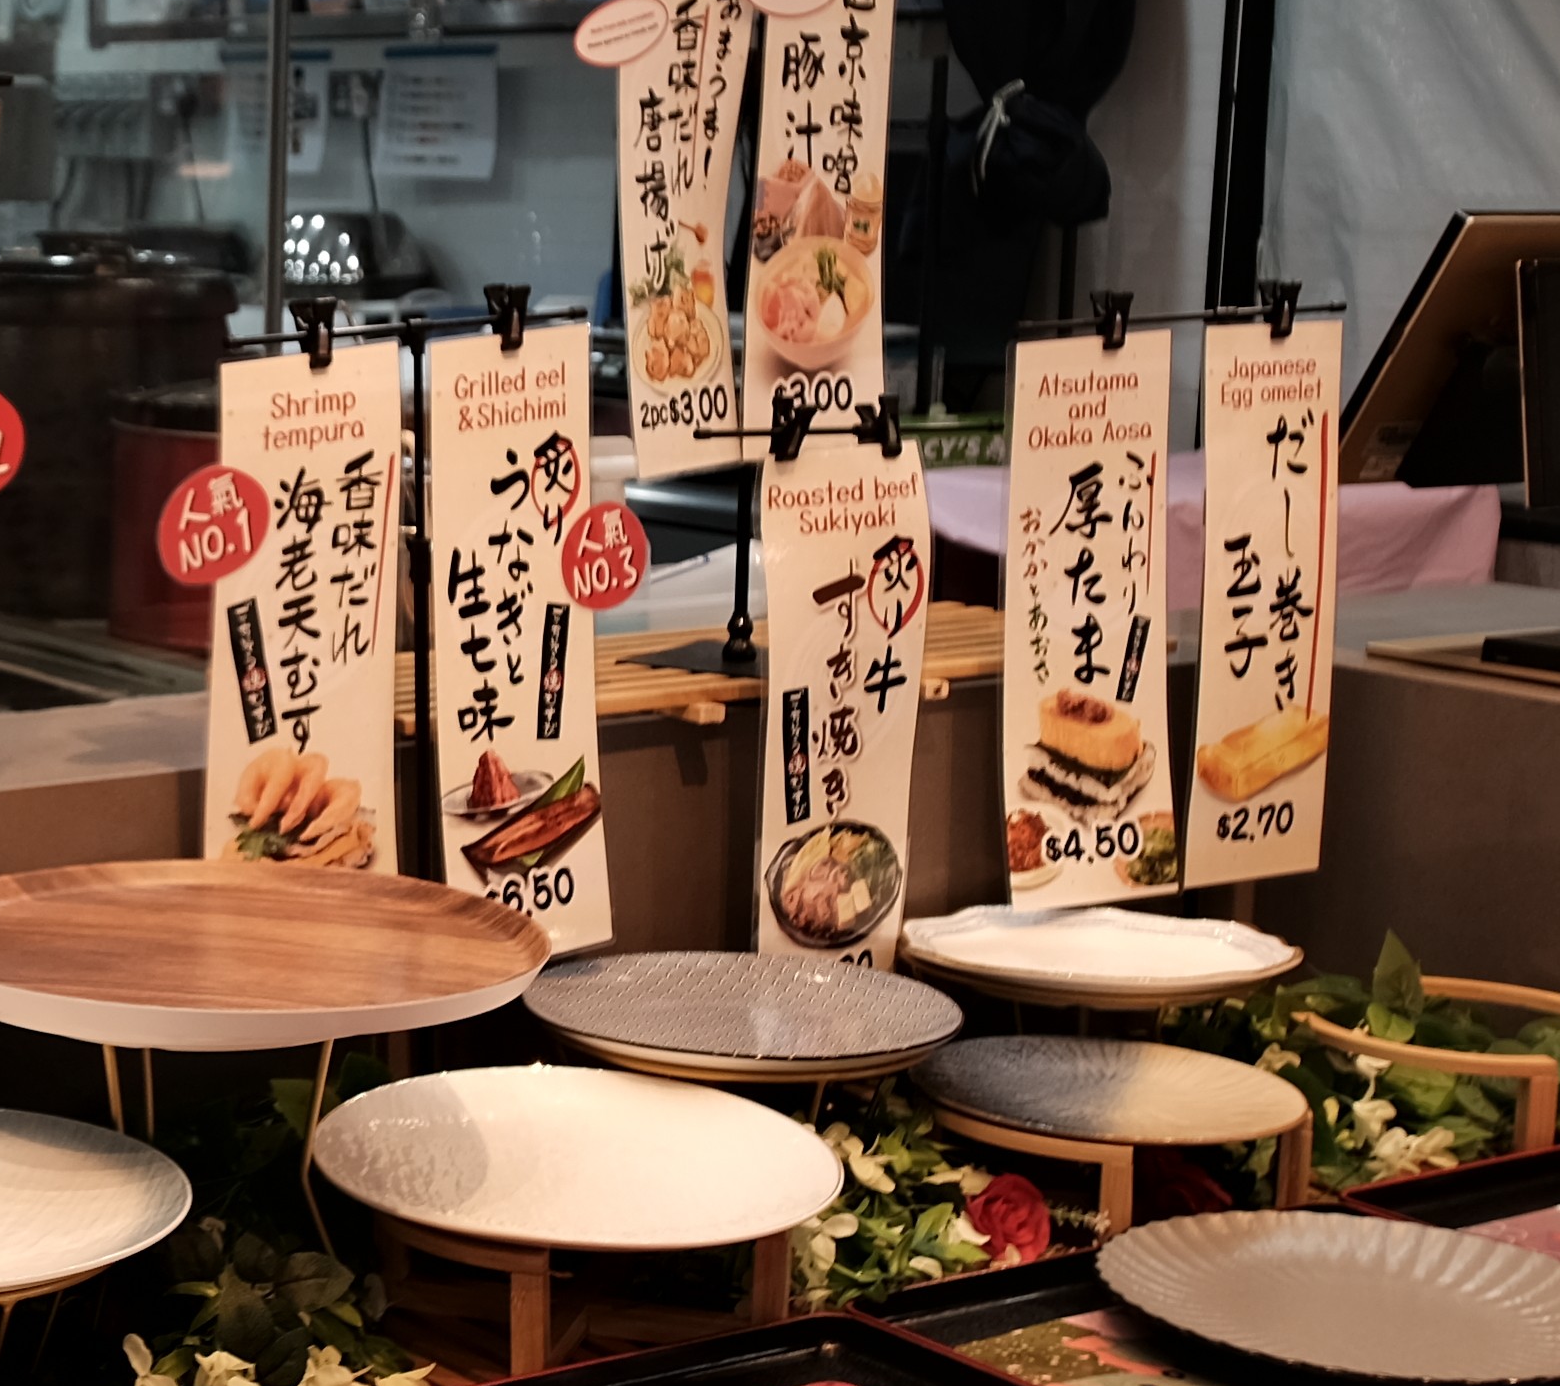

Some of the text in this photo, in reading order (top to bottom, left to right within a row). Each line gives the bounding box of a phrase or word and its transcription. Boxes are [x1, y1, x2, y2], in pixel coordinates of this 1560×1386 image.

[782, 31, 825, 168] 豚汁
[635, 87, 675, 289] 唐揚げ
[454, 361, 566, 401] Grilled eel
[1039, 370, 1139, 398] Atsutama
[1228, 356, 1317, 383] Japanese
[271, 390, 356, 420] Shrimp
[1068, 396, 1107, 420] and
[1220, 380, 1322, 410] Egg omelet
[263, 419, 364, 452] tempura
[1027, 424, 1095, 450] Okaka
[1103, 420, 1152, 444] Aosa
[178, 474, 243, 524] 人氣
[767, 472, 920, 510] Roasted beef
[179, 512, 252, 568] NO.1
[577, 510, 628, 554] 人氣
[799, 507, 897, 536] Sukiyaki
[1119, 451, 1152, 615] ふんわり
[330, 449, 383, 666] 香味だれ
[490, 449, 534, 685] うなぎと
[572, 551, 639, 595] NO.3
[1049, 461, 1113, 684] 厚たま
[1266, 410, 1314, 711] だし巻き
[273, 467, 332, 754] 海老天むす
[1020, 506, 1050, 685] おかかとあおさ
[1223, 535, 1269, 678] 玉子
[447, 546, 514, 743] 生七味
[812, 559, 867, 816] すき焼き
[1046, 823, 1140, 862] $4.50
[1216, 802, 1295, 842] $2.70
